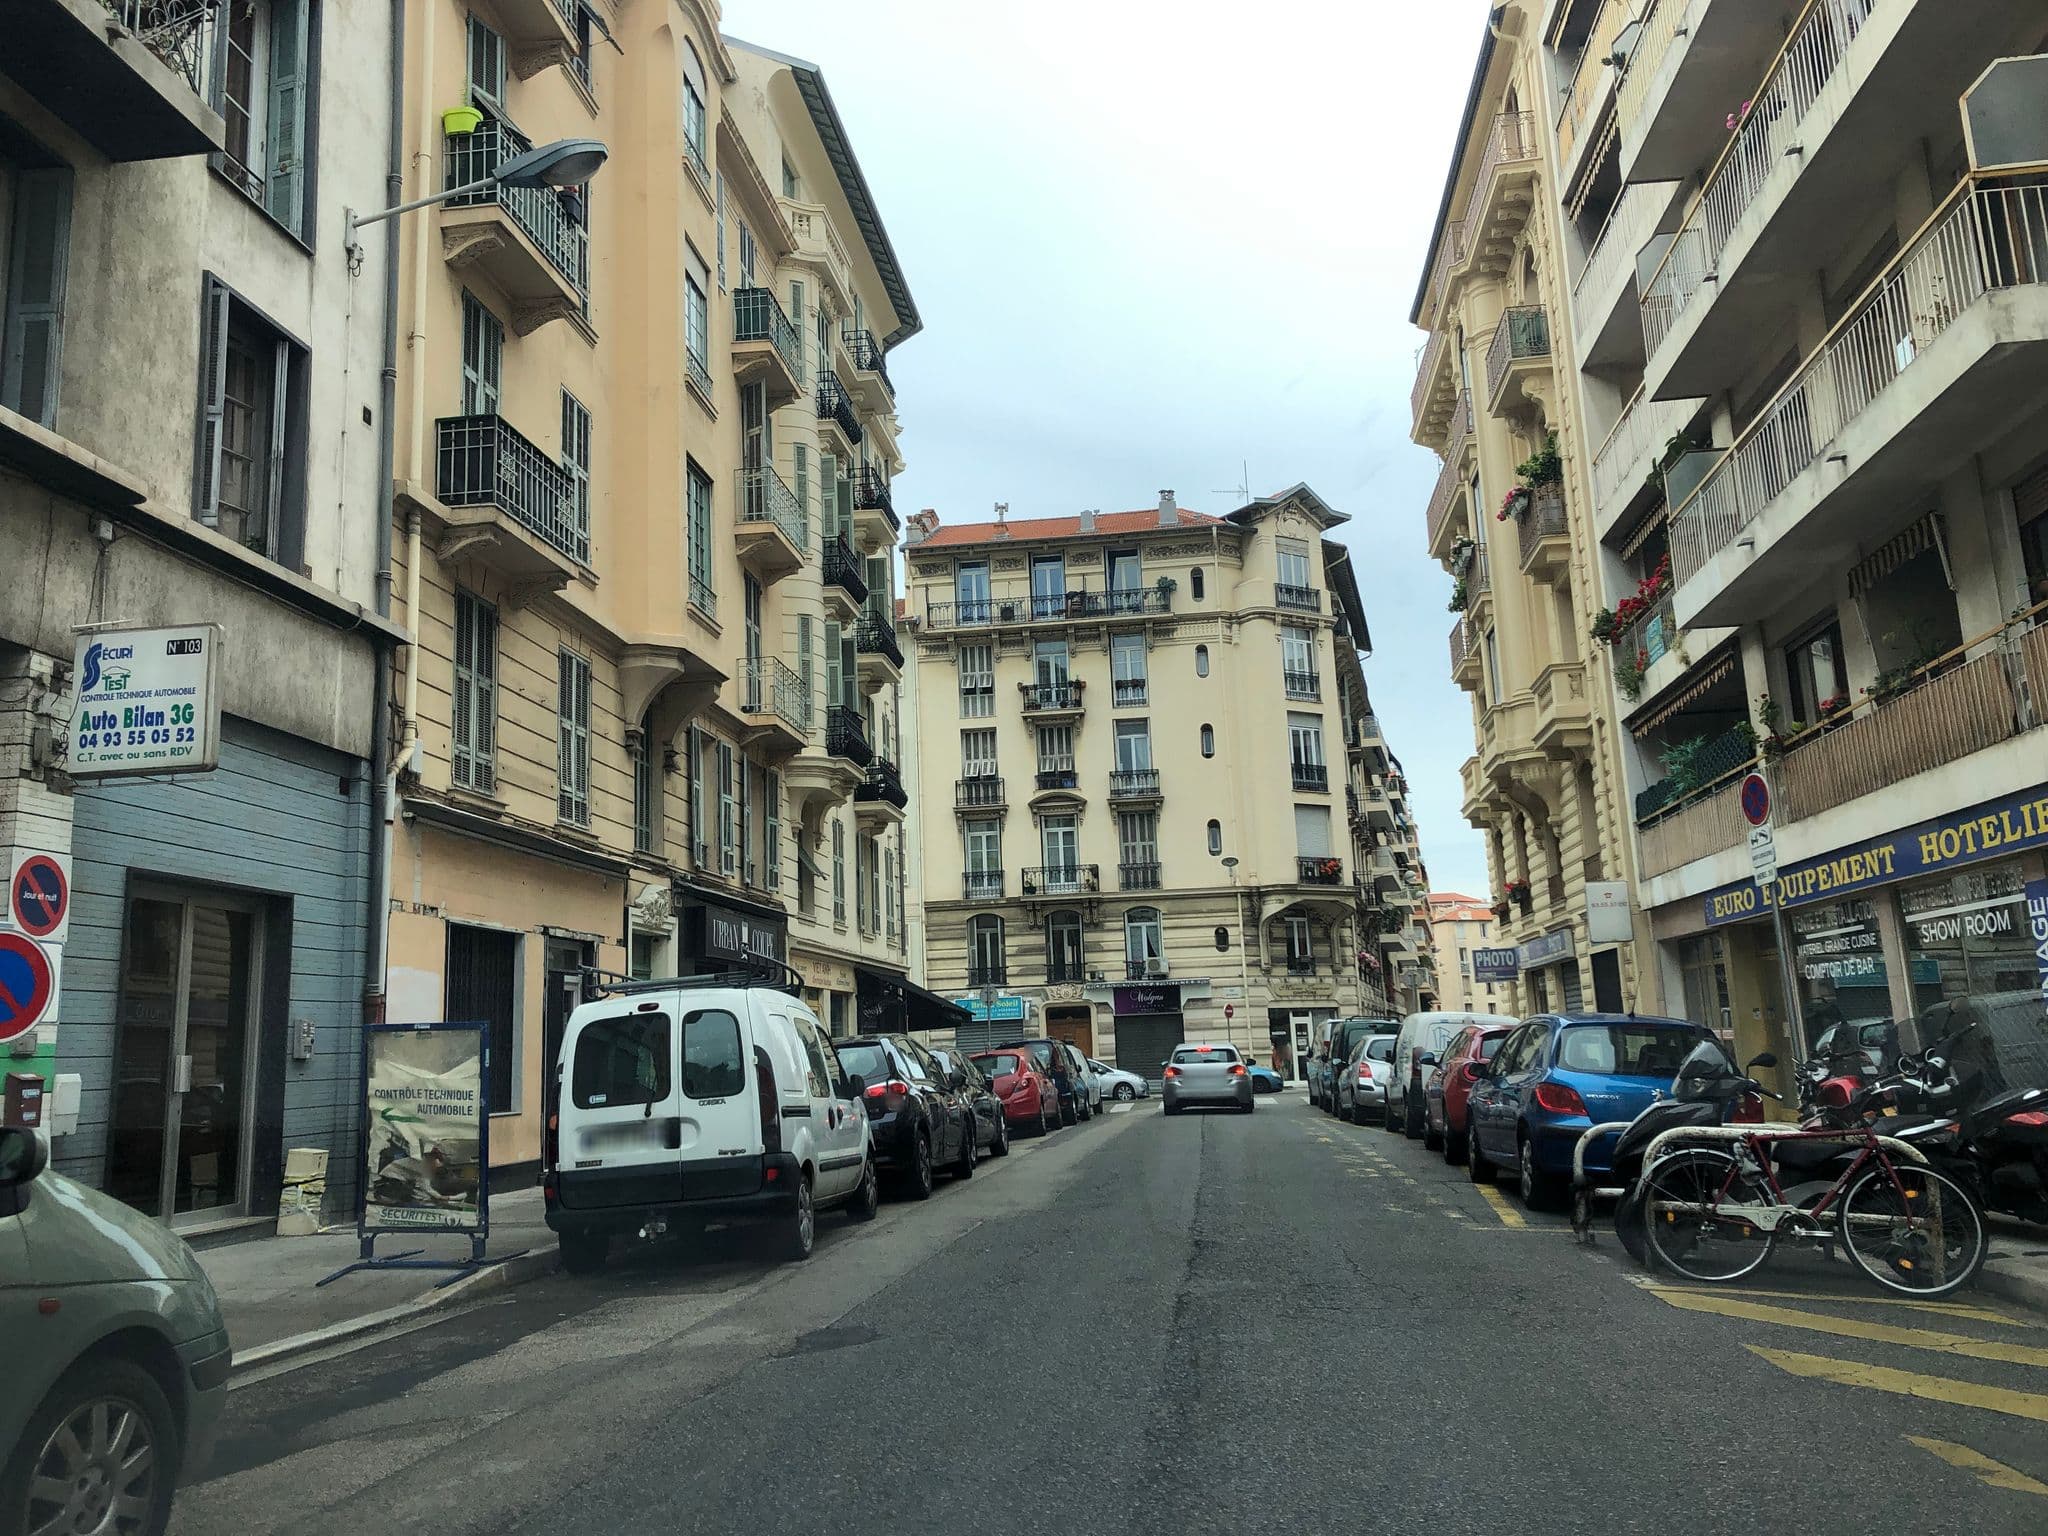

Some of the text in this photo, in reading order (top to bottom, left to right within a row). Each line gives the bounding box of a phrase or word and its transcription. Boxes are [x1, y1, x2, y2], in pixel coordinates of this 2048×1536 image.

[184, 640, 201, 653] 103
[116, 689, 152, 700] TECHNIQUE
[154, 687, 197, 698] AUTOMOBILE
[79, 703, 195, 732] Auto Bilan 3G
[79, 727, 195, 749] 04 93 55 05 52
[77, 746, 193, 763] C.T. avec ou sans RDV
[1713, 887, 1755, 918] EURO
[1762, 844, 1896, 907] EQUIPEMENT
[37, 892, 45, 900] et
[45, 893, 57, 901] nuit
[1921, 909, 2011, 943] SHOW ROOM
[713, 919, 774, 959] URBAN COUPE
[1797, 933, 1877, 957] MATERIEL GRANDE CUISINE
[1475, 951, 1515, 968] PHOTO
[1804, 957, 1875, 980] COMPTOIR DE BAR
[374, 1086, 474, 1101] CONTRÔLE TECHNIQUE
[417, 1103, 473, 1116] AUTOMOBILE
